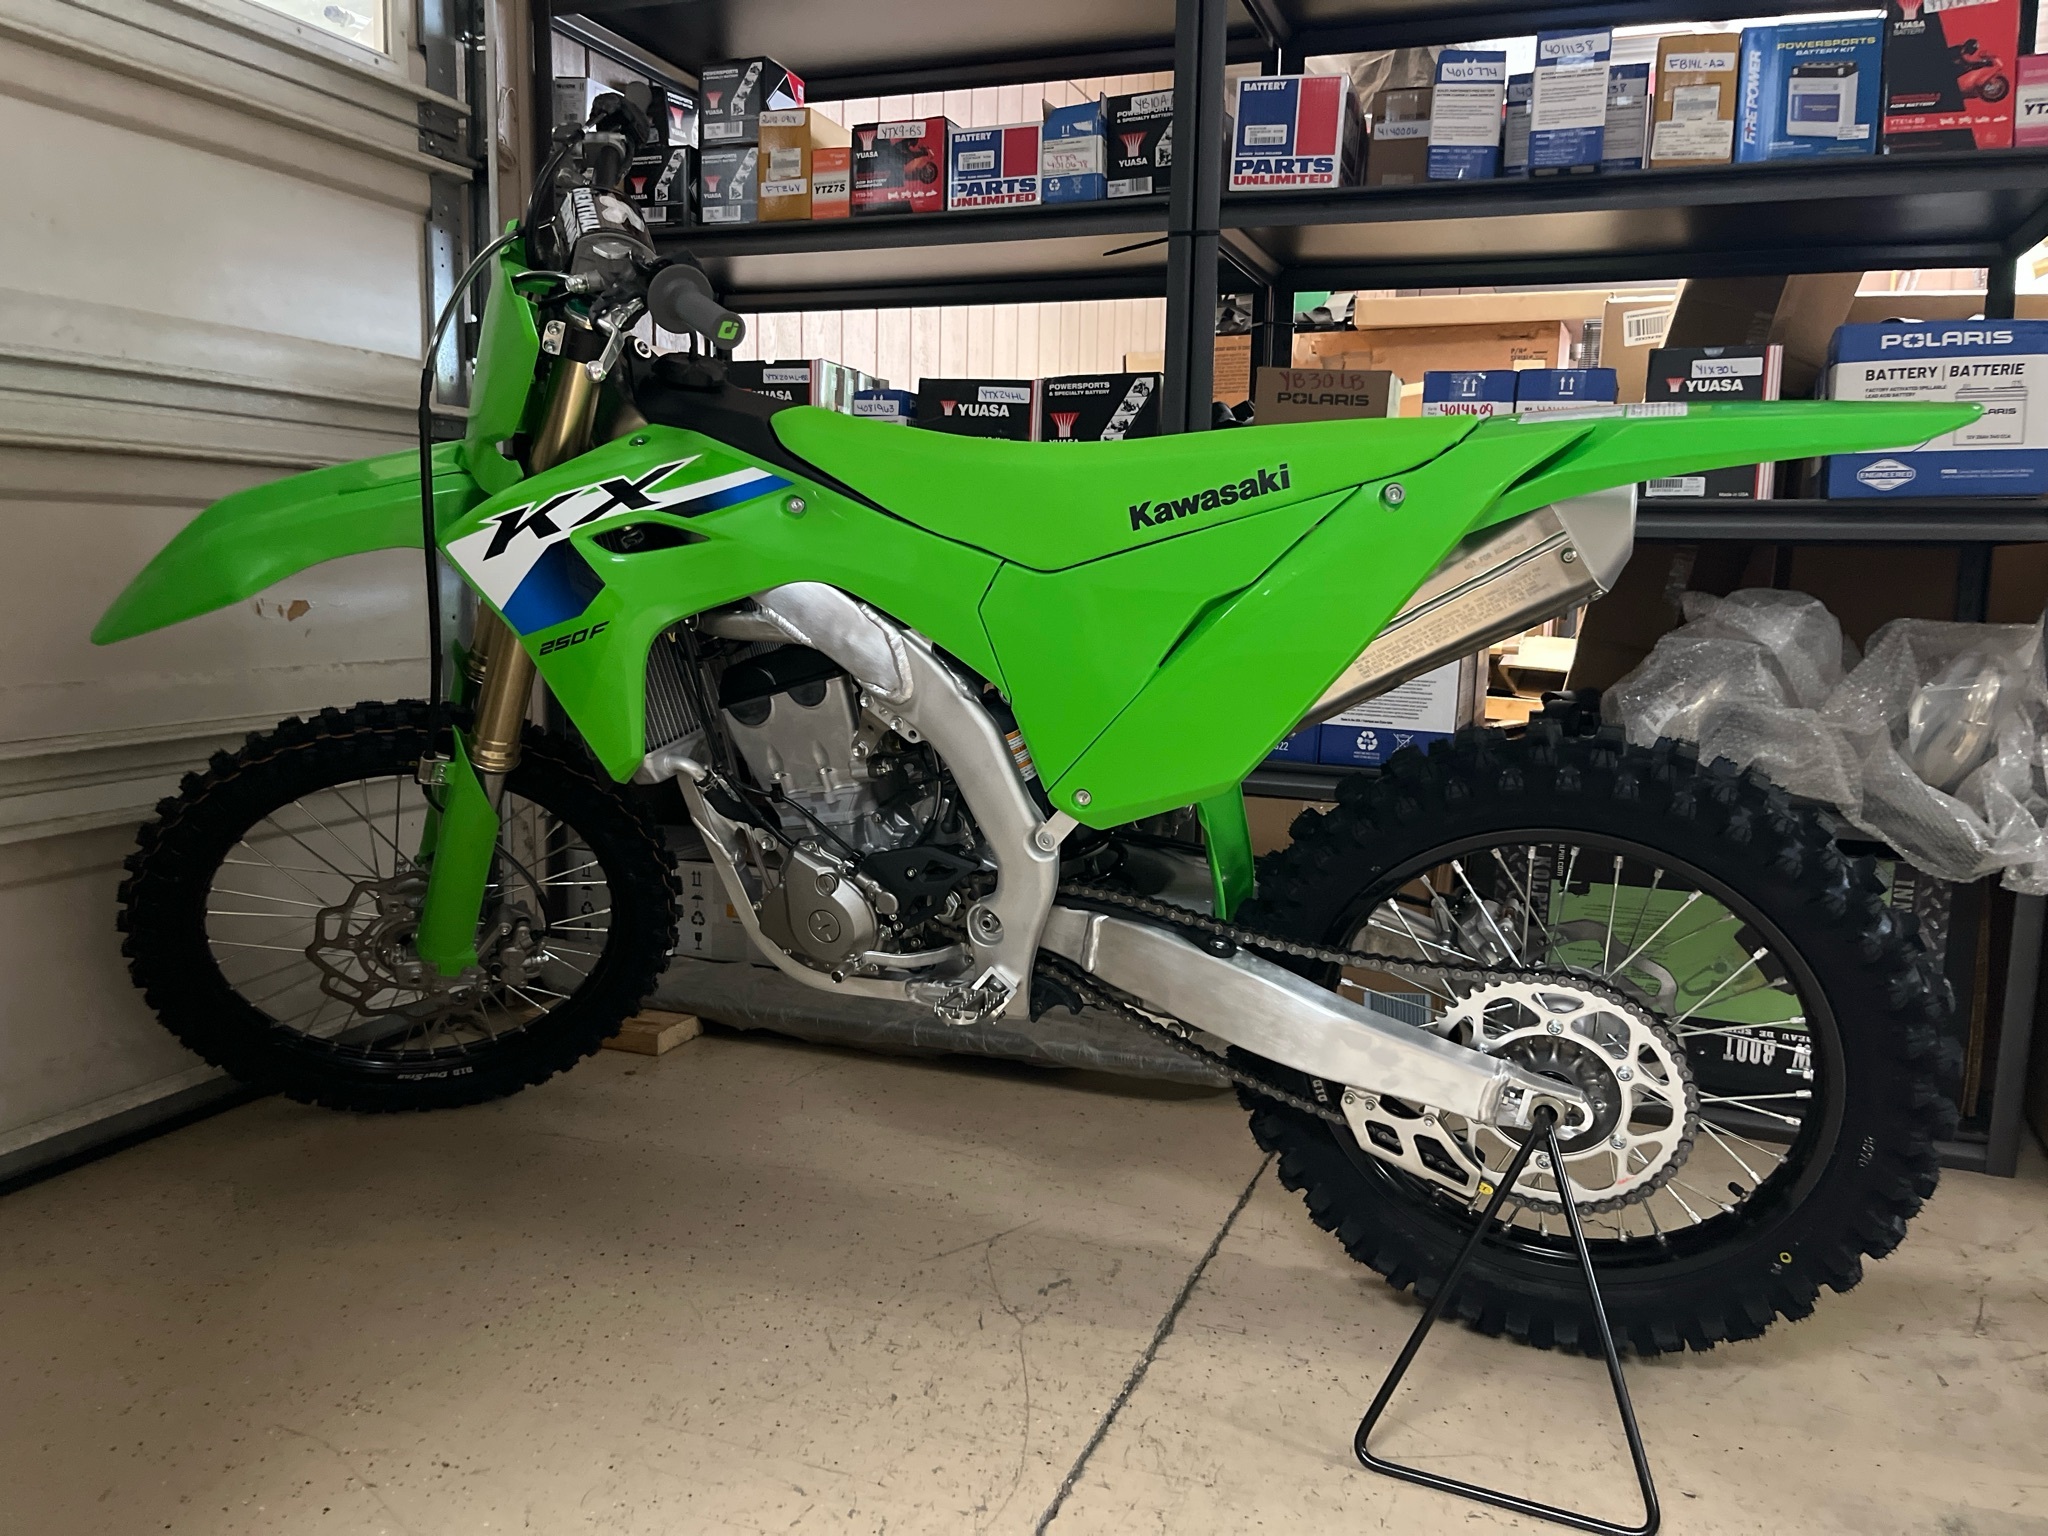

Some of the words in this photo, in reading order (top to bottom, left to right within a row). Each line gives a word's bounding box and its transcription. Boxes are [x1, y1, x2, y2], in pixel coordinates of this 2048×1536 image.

[1893, 20, 1926, 29] YUASA
[1893, 27, 1925, 36] BATTERY
[1545, 40, 1594, 54] 4011138
[1777, 37, 1876, 50] POWERSPORTS
[1795, 47, 1838, 56] BATTERY
[1446, 67, 1497, 77] 4010774
[1243, 81, 1287, 91] BATTERY
[2024, 104, 2048, 115] YT
[881, 126, 922, 138] YTX9-BS
[955, 132, 992, 143] BATTERY
[856, 150, 878, 159] YUASA
[1118, 157, 1148, 167] YUASA
[1234, 158, 1333, 174] PARTS
[1233, 174, 1332, 185] UNLIMITED
[814, 184, 846, 195] YTZ7S
[951, 178, 1037, 196] PARTS
[951, 192, 1037, 207] UNLIMITED
[573, 188, 600, 233] RENTHAL
[1880, 330, 2014, 350] POLARIS
[1865, 366, 1938, 381] BATTERY
[1950, 363, 2026, 378] BATTERIE
[1049, 381, 1110, 390] POWERSPORTS
[1685, 379, 1744, 393] YUASA
[1277, 392, 1369, 406] POLARIS
[957, 403, 1010, 417] YUASA
[1439, 403, 1494, 416] 4014609
[1128, 463, 1291, 531] Kawasaki
[482, 457, 692, 562] KX
[539, 621, 610, 657] 250F
[1722, 1037, 1778, 1066] BOOT
